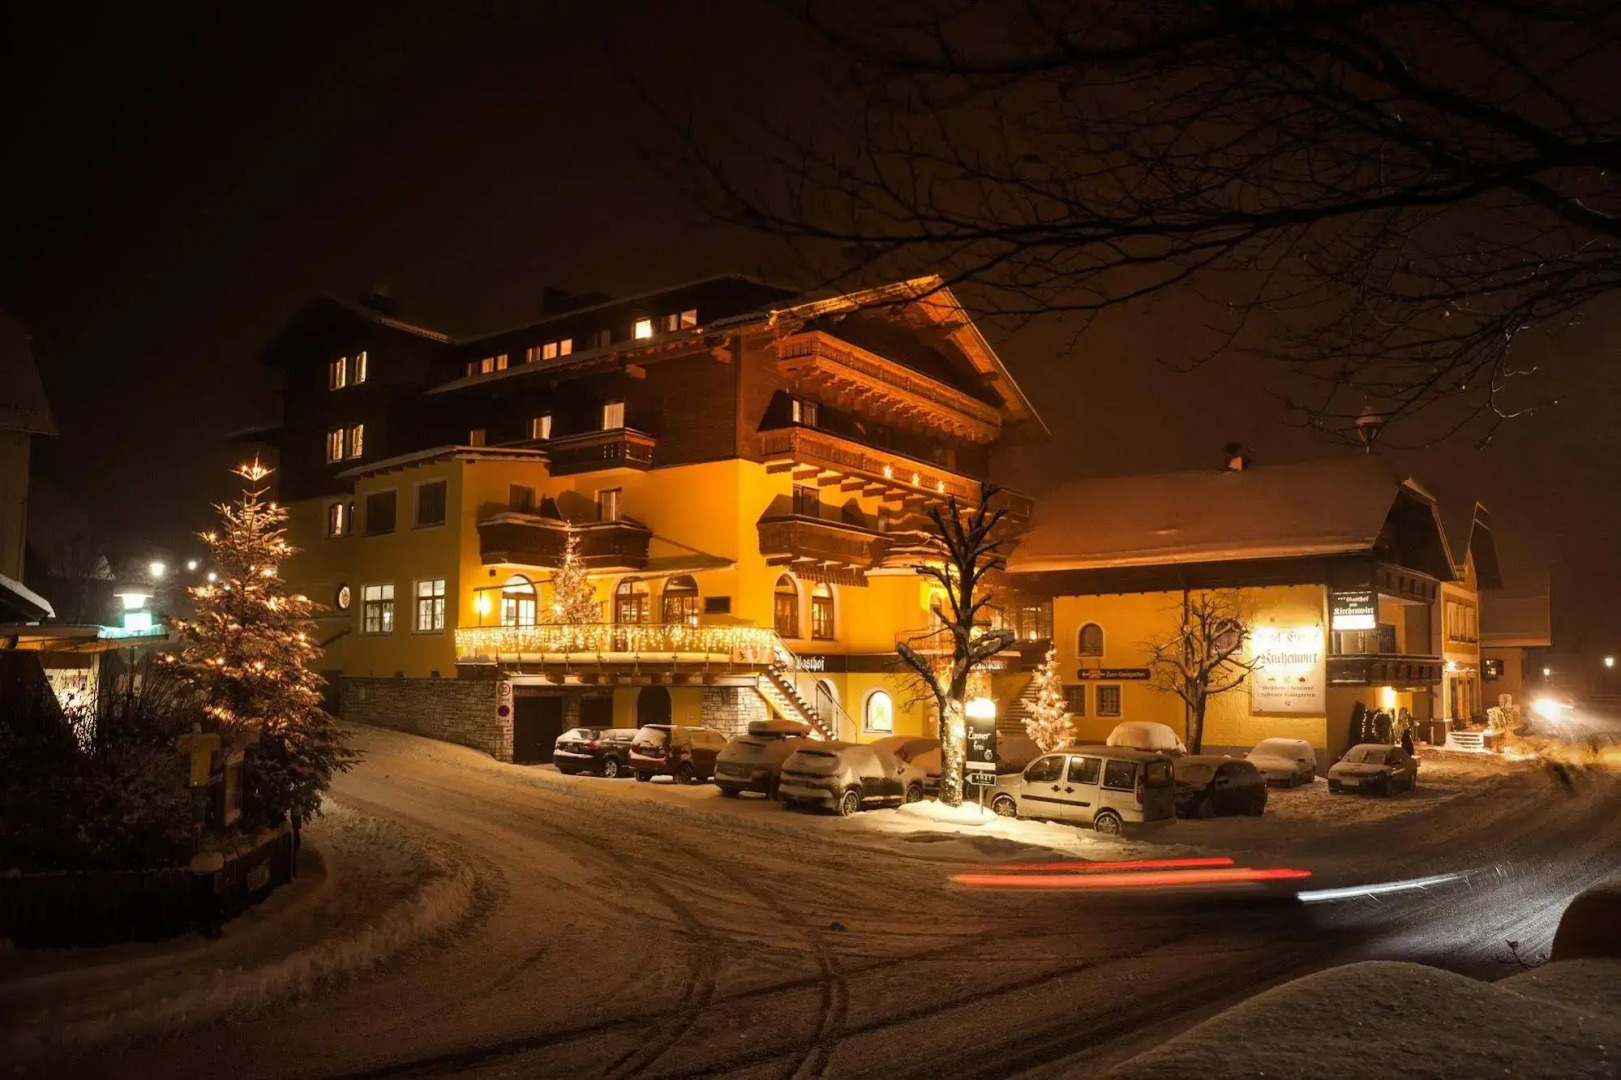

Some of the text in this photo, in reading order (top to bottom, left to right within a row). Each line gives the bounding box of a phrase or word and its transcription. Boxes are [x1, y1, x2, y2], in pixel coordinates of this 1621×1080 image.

[1345, 595, 1369, 603] Gasthof
[1333, 607, 1374, 615] Kirchenwirt
[973, 740, 984, 751] frei
